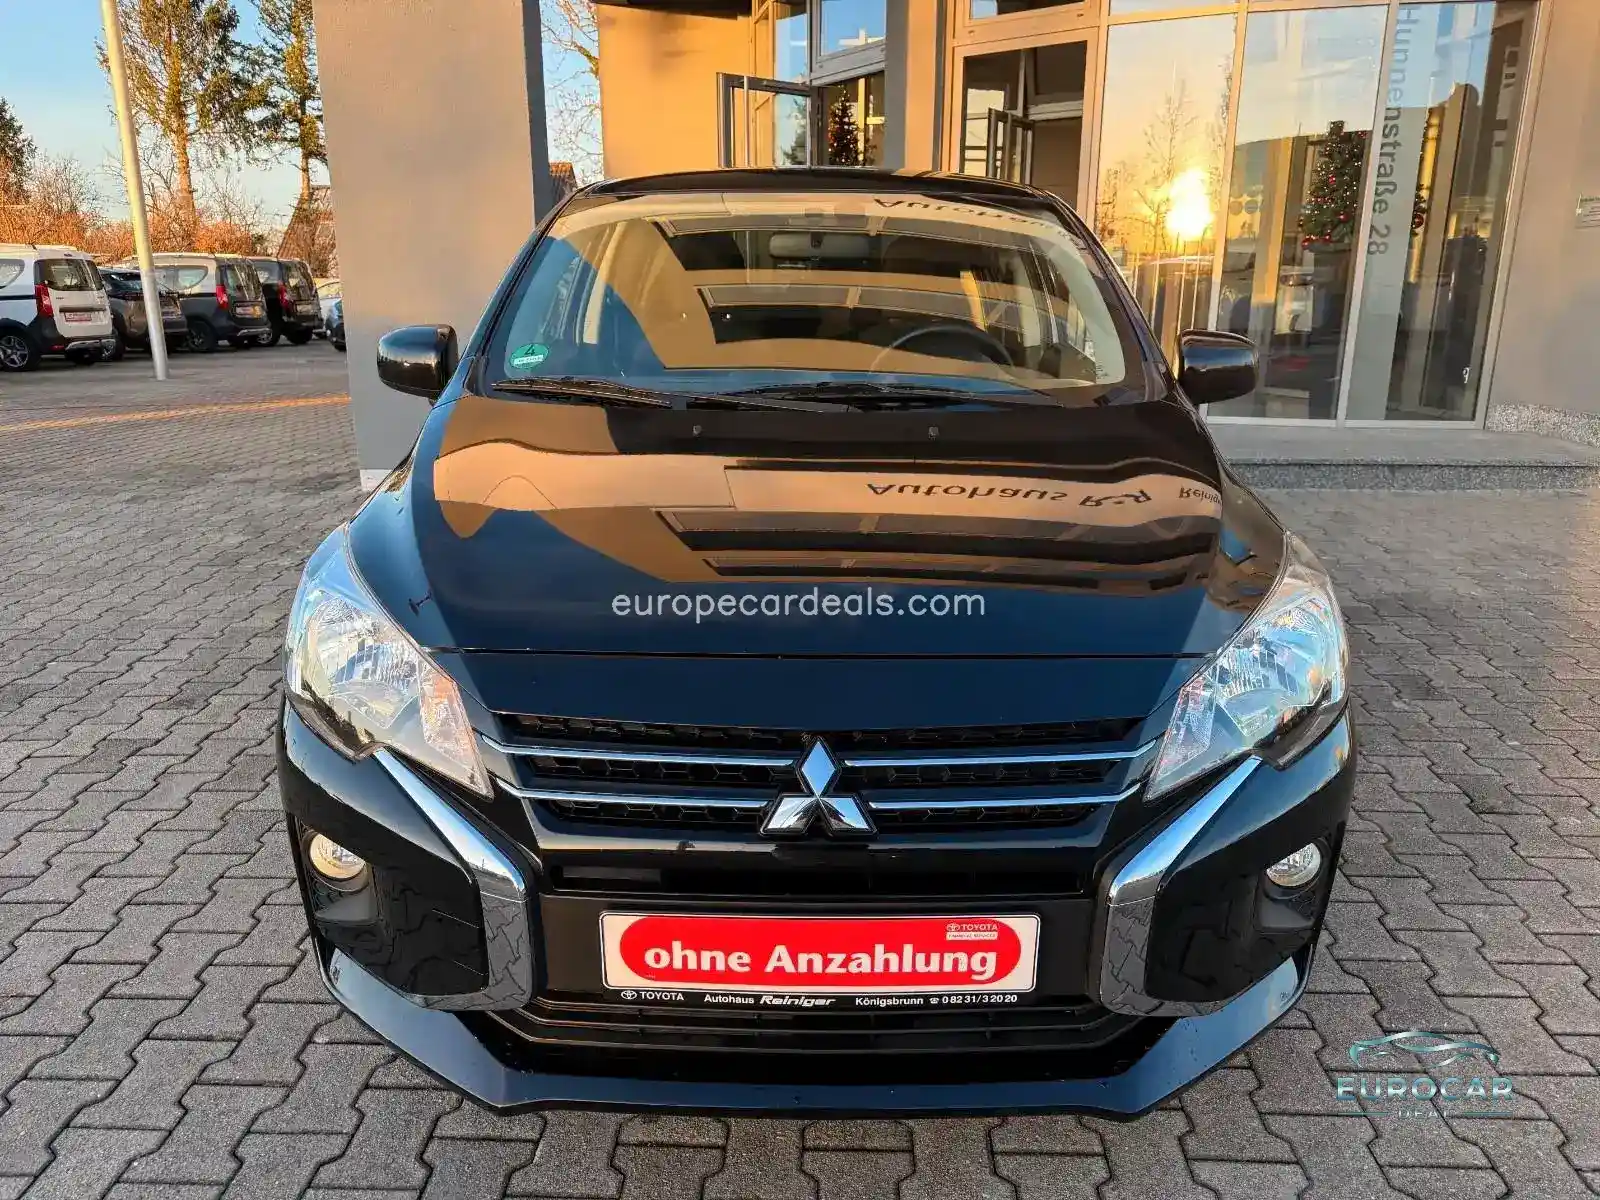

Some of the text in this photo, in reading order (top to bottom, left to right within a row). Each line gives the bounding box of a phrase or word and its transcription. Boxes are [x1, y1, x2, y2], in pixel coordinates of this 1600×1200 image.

[1367, 4, 1421, 255] Hunnenstraße 28
[524, 344, 536, 356] 4
[961, 923, 998, 931] TOYOTA
[643, 940, 997, 981] ohne Anzahlung
[640, 991, 685, 1001] TOYOTA
[704, 994, 755, 1004] Autohaus
[759, 995, 837, 1007] Reiniger
[855, 997, 924, 1007] Königsbrunn
